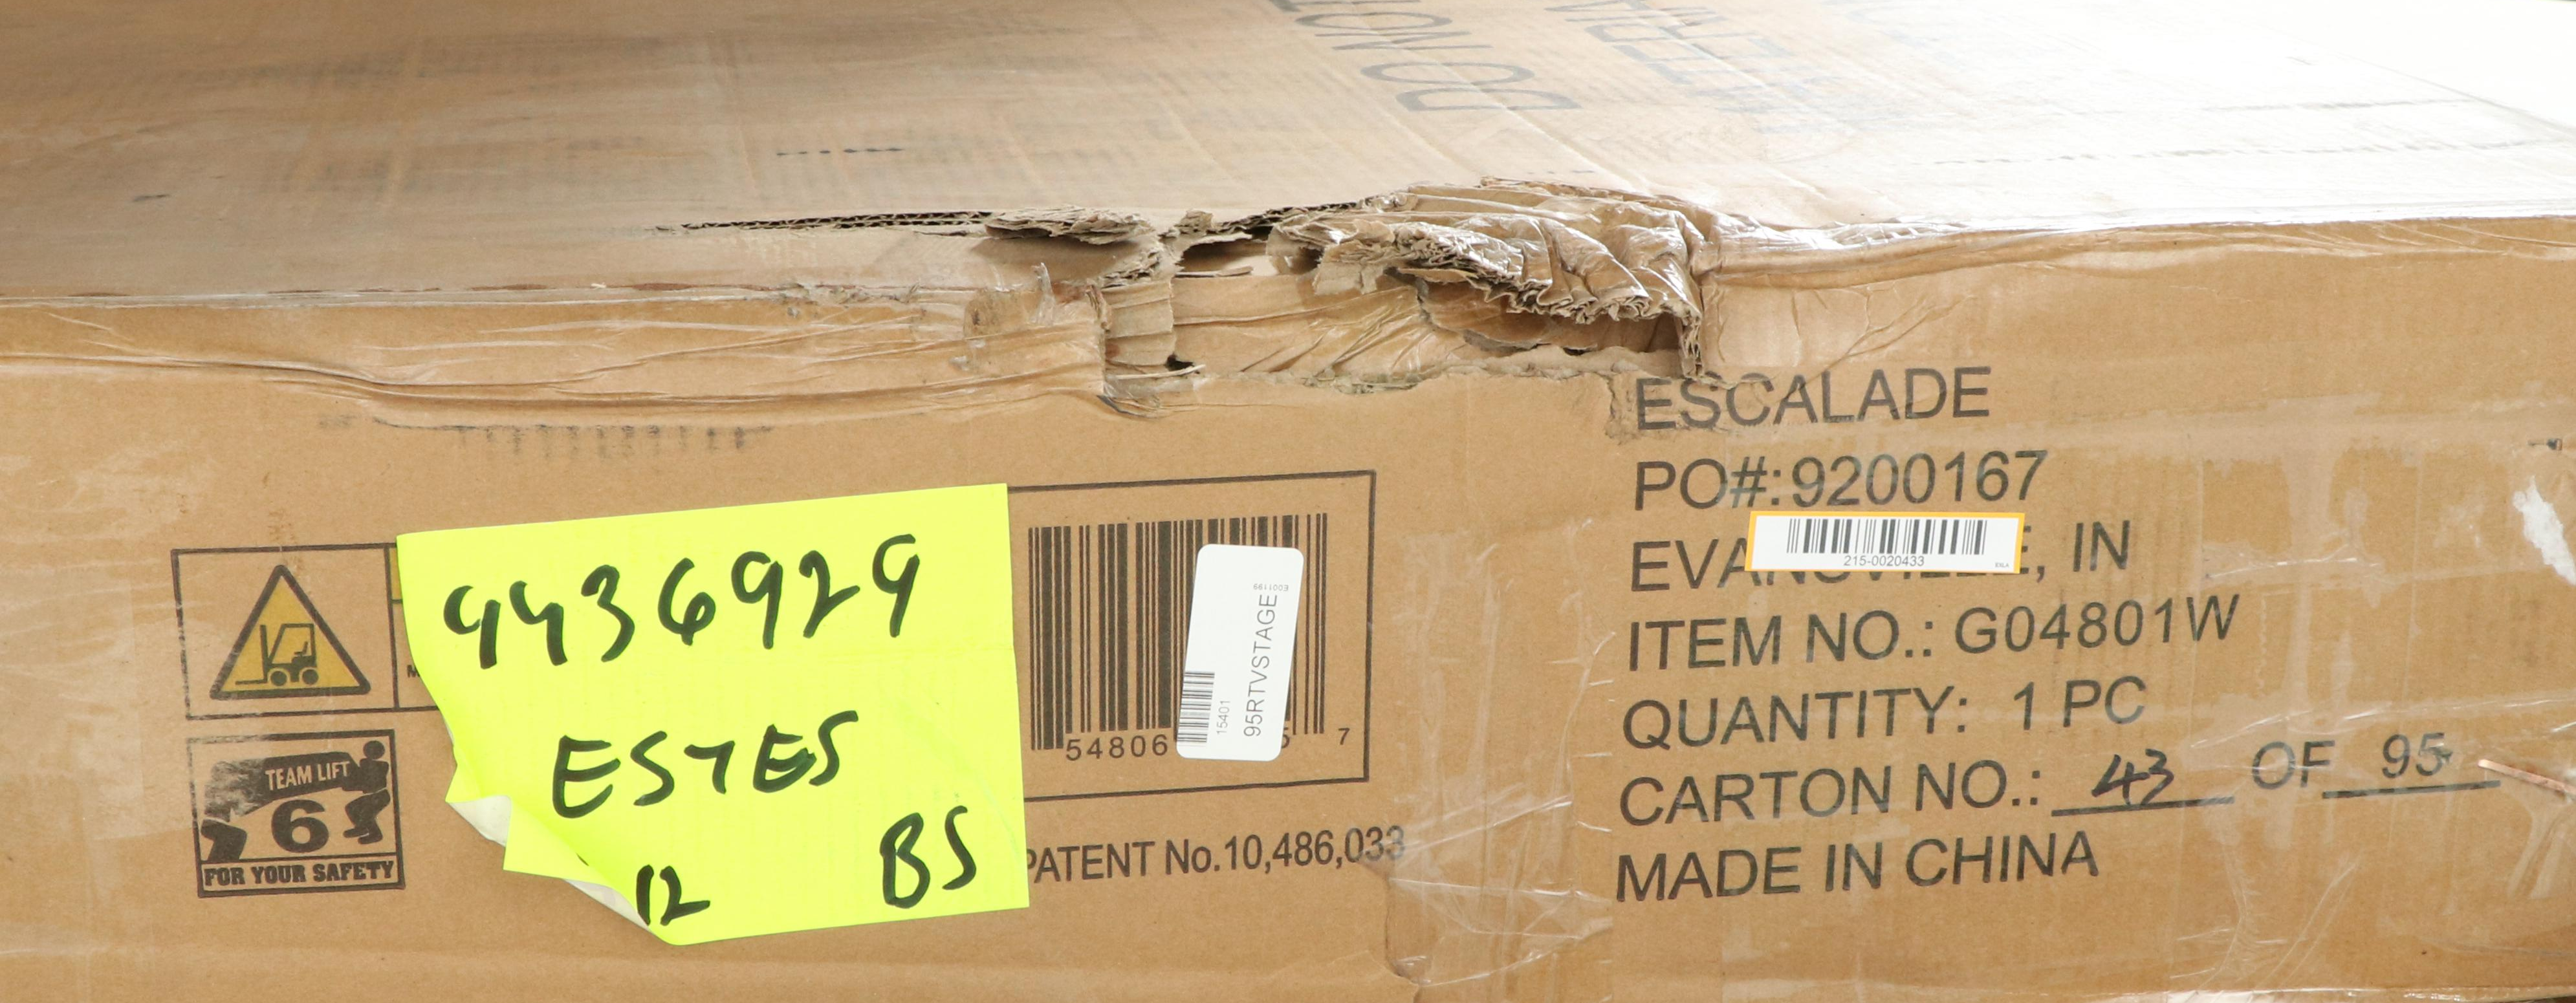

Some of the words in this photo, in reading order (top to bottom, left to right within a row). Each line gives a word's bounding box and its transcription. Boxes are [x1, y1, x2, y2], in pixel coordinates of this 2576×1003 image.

[1360, 62, 1582, 111] DO
[1635, 366, 1991, 430] ESCALADE
[1844, 555, 1925, 566] 215-0020433
[2073, 520, 2130, 572] IN
[1629, 614, 1782, 671] ITEM
[1806, 610, 1934, 663] NO.:
[1954, 594, 2240, 654] G04801W
[1243, 594, 1277, 737] 95RTVSTAGE
[1216, 700, 1230, 735] 15401
[1622, 685, 1968, 750] QUANTITY:
[2013, 682, 2033, 731] 1
[2064, 676, 2145, 728] PC
[265, 764, 312, 791] TEAM
[317, 761, 350, 781] LIFT
[552, 710, 859, 819] ESTES
[1620, 766, 1890, 826] CARTON
[1916, 760, 2040, 811] NO.:
[2091, 748, 2175, 809] 43
[2252, 740, 2335, 790] OF
[2382, 732, 2447, 779] 95
[271, 799, 329, 853] 6
[880, 805, 977, 908] BS
[204, 867, 245, 886] FOR
[250, 865, 307, 884] YOUR
[312, 861, 393, 881] SAFETY
[1616, 846, 1802, 902] MADE
[1824, 841, 1883, 891] IN
[1905, 830, 2099, 886] CHINA
